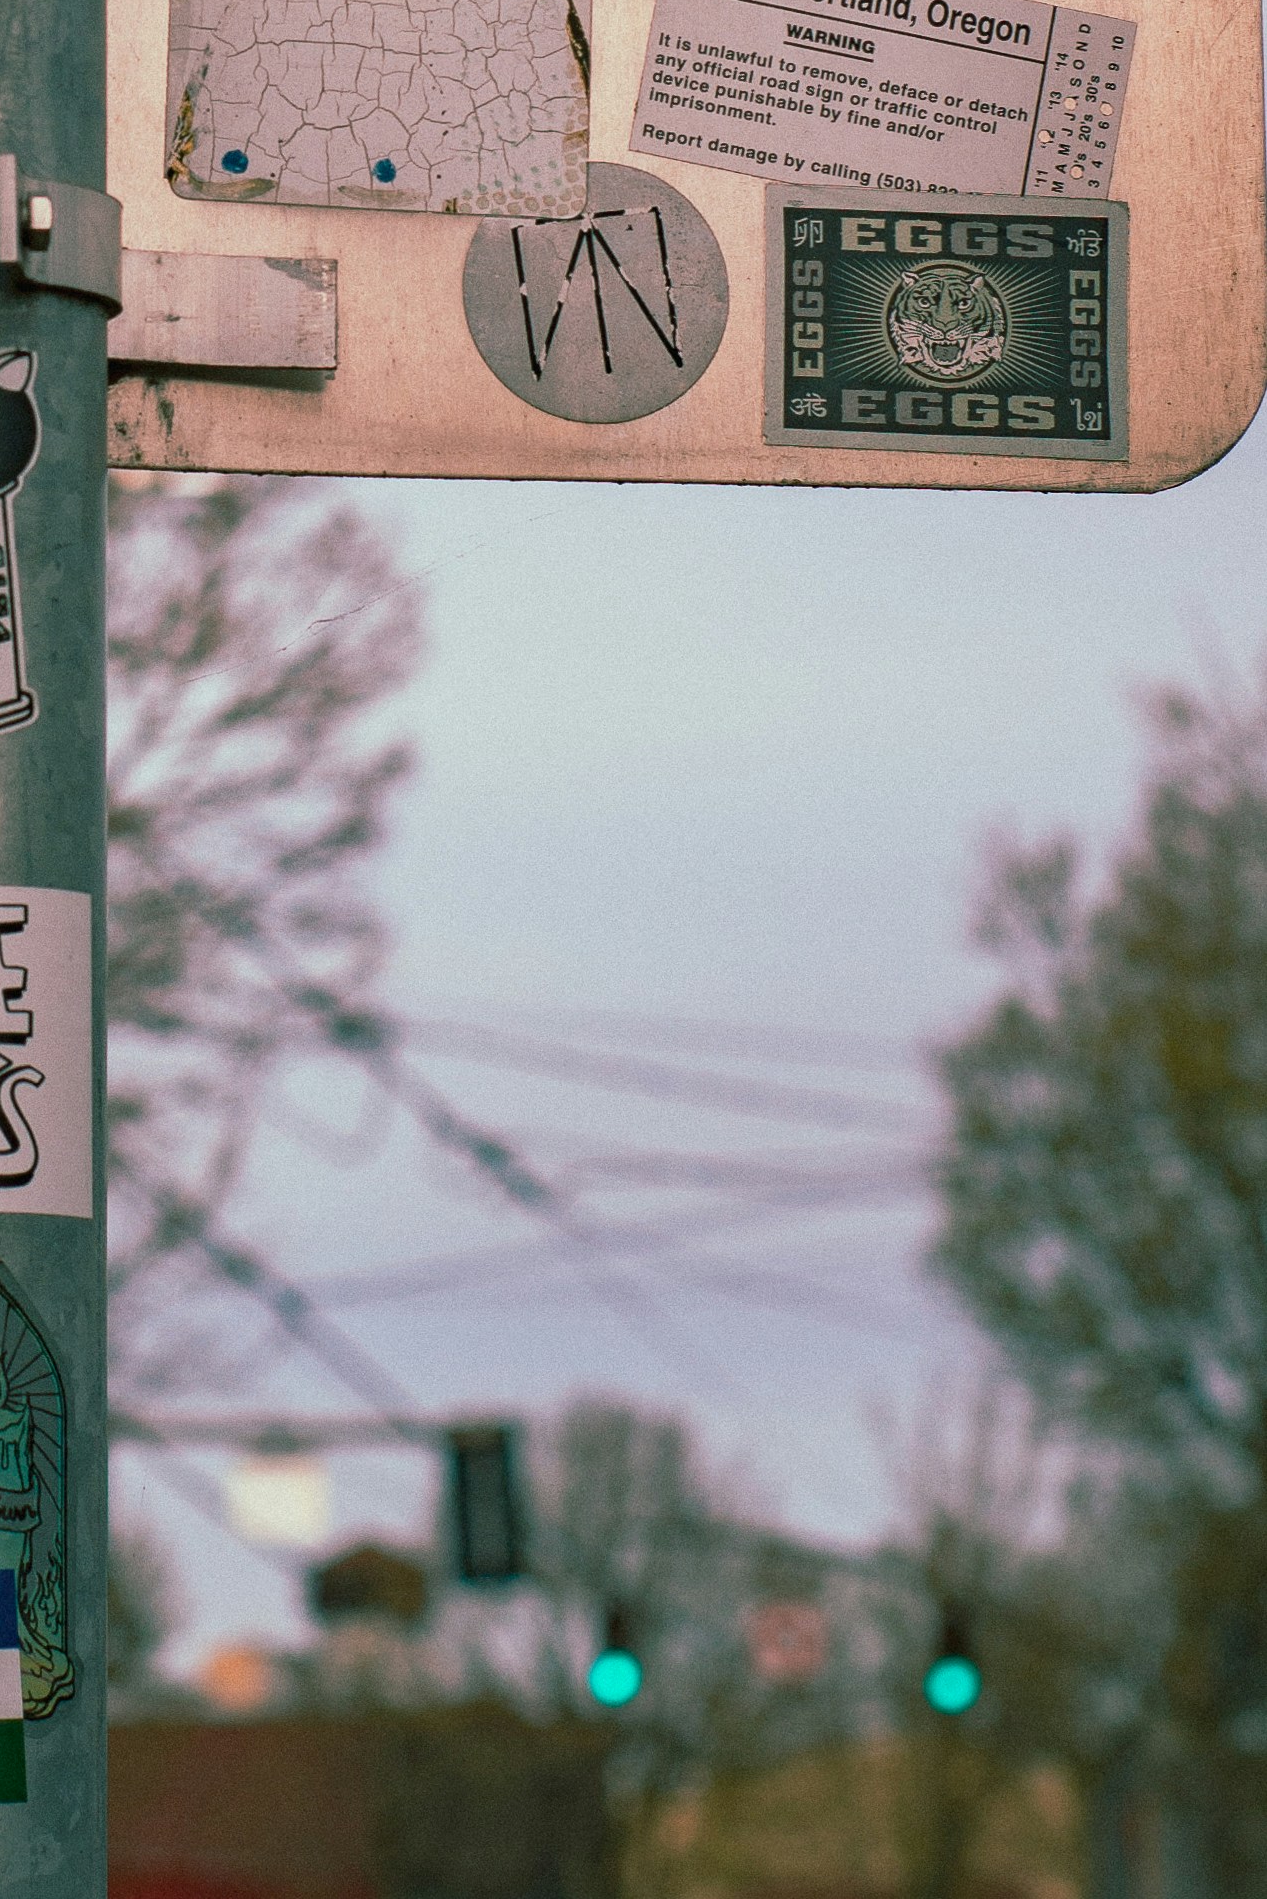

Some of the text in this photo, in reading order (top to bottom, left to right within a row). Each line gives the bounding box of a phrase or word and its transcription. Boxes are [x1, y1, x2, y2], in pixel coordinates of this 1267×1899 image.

[786, 24, 875, 54] WARNING
[927, 0, 1031, 46] Oregon
[654, 53, 997, 135] any official road sign or traffic control
[658, 32, 1029, 122] It is unlawful to remove, deface or detach
[1085, 75, 1100, 103] 30's
[648, 87, 777, 126] imprisonment.
[652, 70, 946, 142] device punishable by fine and/or
[1078, 113, 1094, 142] 20's
[642, 123, 704, 149] Report
[708, 138, 778, 165] damage
[783, 152, 805, 172] by
[810, 160, 872, 186] calling
[877, 172, 922, 192] (503)
[793, 217, 824, 248] 卵
[840, 217, 1054, 259] EGGS
[792, 259, 825, 378] EGGS
[1069, 269, 1102, 388] EGGS
[841, 389, 1056, 430] EGGS
